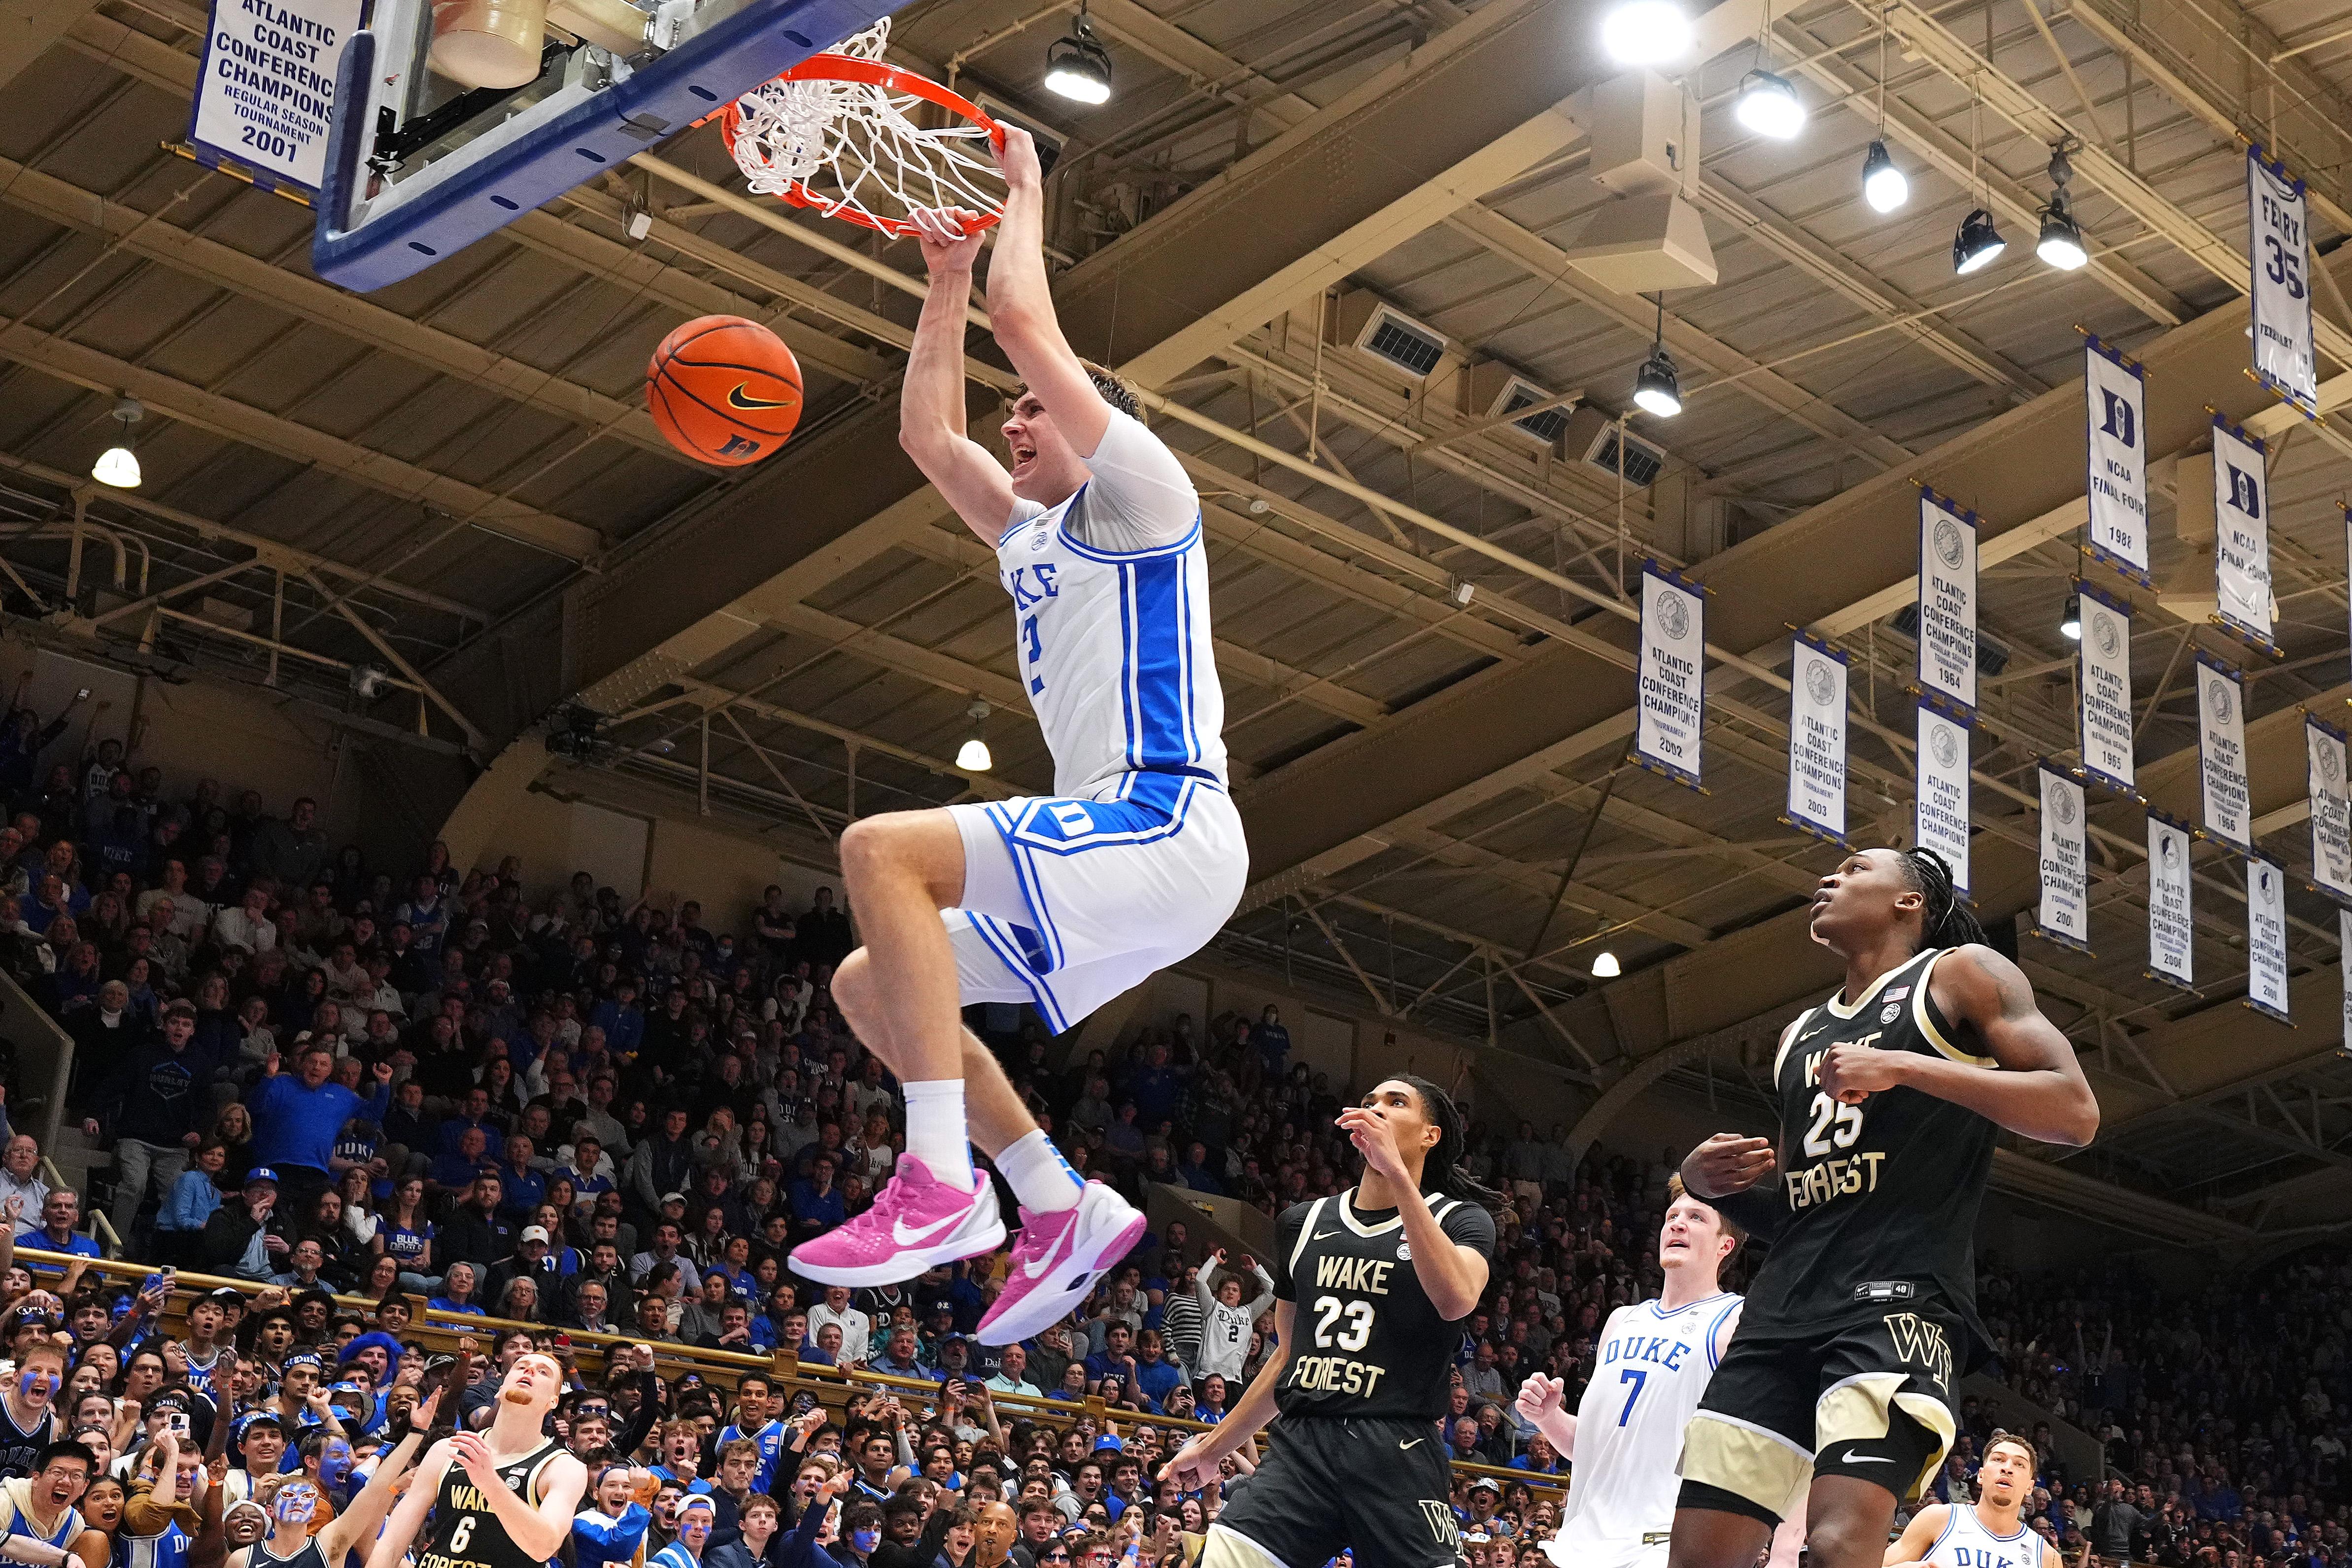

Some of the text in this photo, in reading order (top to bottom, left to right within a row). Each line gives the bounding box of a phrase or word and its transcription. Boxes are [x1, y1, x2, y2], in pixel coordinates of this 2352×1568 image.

[241, 0, 335, 46] ATLANTIC
[254, 24, 319, 64] COAST
[216, 32, 333, 98] CONFERENC
[218, 58, 333, 124] CHAMPIONS
[224, 84, 323, 136] REGULAR SEASON
[234, 102, 311, 145] TOURNAMENT
[241, 125, 297, 163] 2001
[2265, 235, 2304, 299] 35
[2107, 458, 2132, 483] NCAA
[2093, 477, 2145, 517] FINAL FOUR
[2233, 531, 2256, 553] NCAA
[1008, 563, 1058, 611] KE
[1932, 575, 1966, 605] ATLANTIC
[1937, 595, 1961, 618] COAST
[1924, 605, 1974, 643] CONFERENCE
[1926, 623, 1972, 659] CHAMPIONS
[1652, 647, 1694, 675] ATLANTIC
[1659, 666, 1686, 689] COAST
[1642, 676, 1699, 713] CONFERENCE
[1939, 667, 1960, 689] 1964
[2097, 683, 2119, 703] COAST
[1644, 694, 1696, 728] CHAMPIONS
[1802, 714, 1838, 740] ATLANTIC
[1654, 717, 1687, 739] TOURNAMENT
[1807, 733, 1832, 753] COAST
[1659, 736, 1683, 758] 2002
[1793, 742, 1844, 775] CONFERENCE
[1795, 759, 1841, 790] CHAMPIONS
[1928, 775, 1960, 799] ATLANTIC
[1808, 799, 1827, 817] 2003
[1920, 802, 1967, 833] CONFERENCE
[1933, 792, 1956, 812] COAST
[1922, 818, 1965, 847] CHAMPIONS
[1804, 1091, 1863, 1158] 25
[1785, 1152, 1885, 1212] FOREST
[397, 1233, 419, 1245] BLUE
[1316, 1256, 1395, 1295] WAKE
[1228, 1325, 1239, 1343] 2
[1313, 1295, 1375, 1352] 23
[1604, 1336, 1691, 1372] DUKE
[1288, 1355, 1385, 1398] FOREST
[1618, 1369, 1647, 1427] 7
[451, 1485, 495, 1514] WAK
[450, 1516, 477, 1554] 6
[1954, 1547, 2013, 1568] DUK
